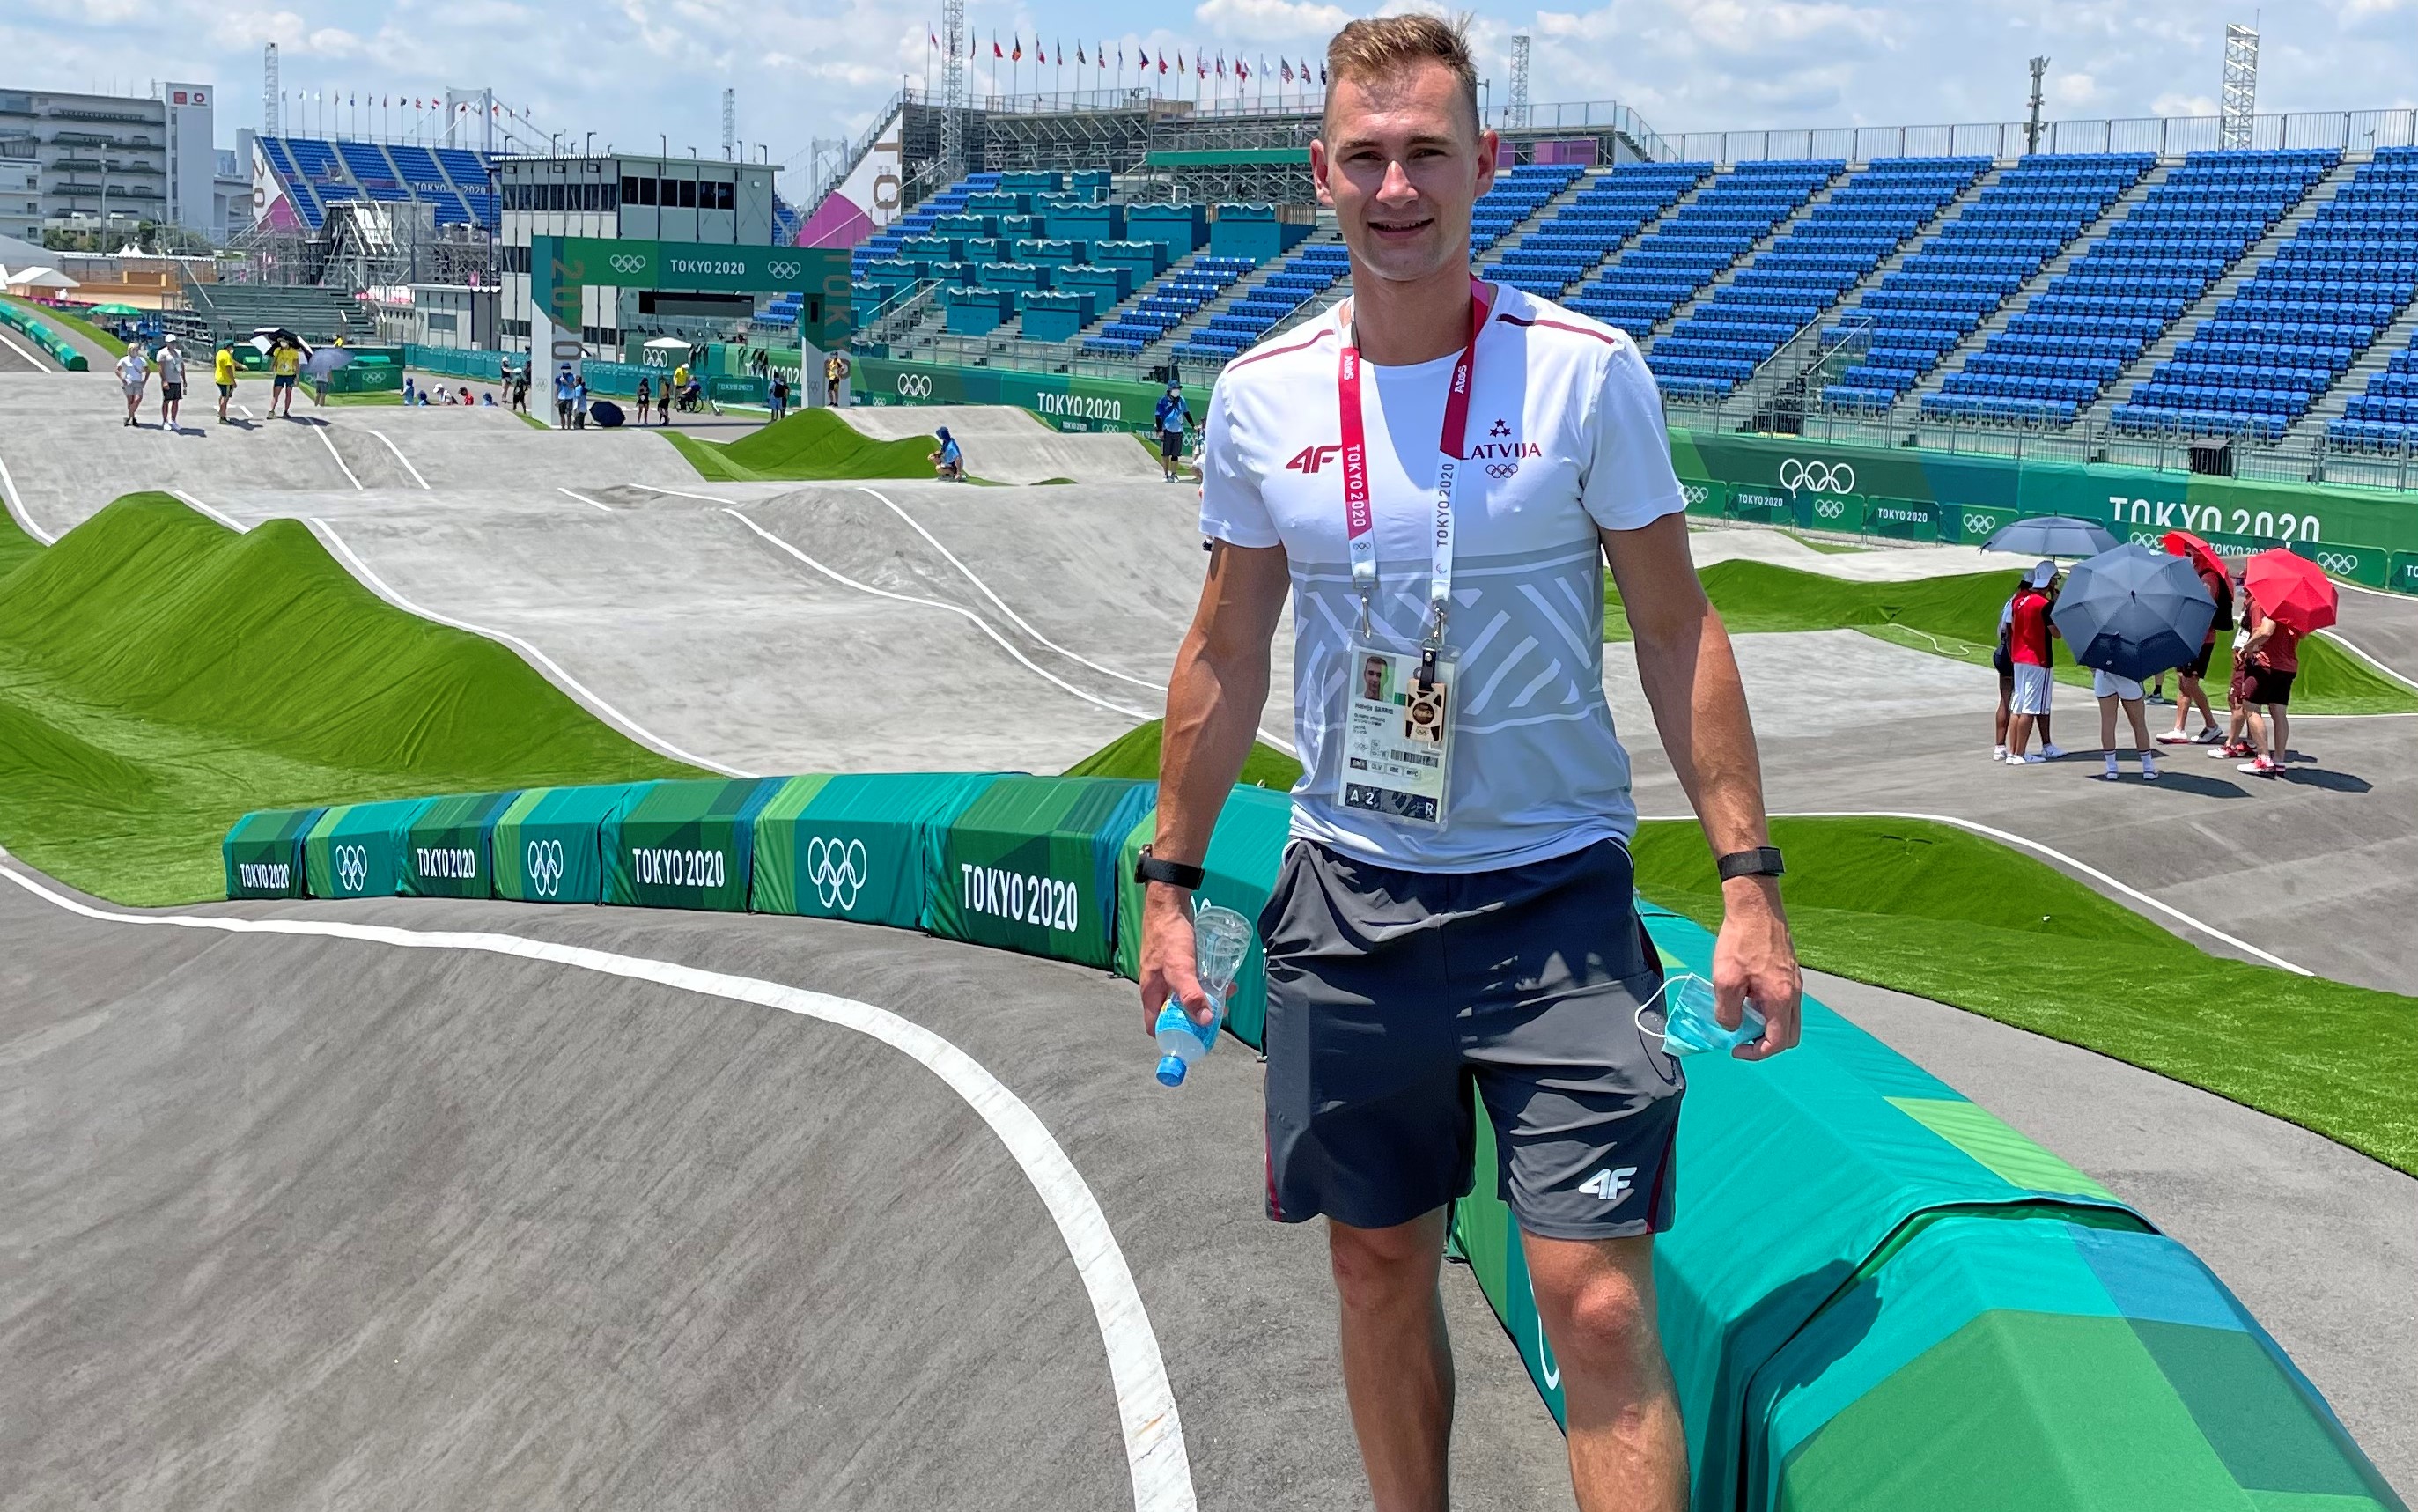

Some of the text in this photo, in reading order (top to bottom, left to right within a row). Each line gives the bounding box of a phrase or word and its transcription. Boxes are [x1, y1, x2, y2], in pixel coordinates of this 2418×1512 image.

[415, 182, 486, 195] TOKYO 2020
[670, 259, 746, 275] TOKYO 2020
[1344, 355, 1354, 380] Atos
[1455, 365, 1467, 394] Atos
[1037, 392, 1121, 421] TOKYO 2020
[1286, 445, 1343, 473] 4F
[1461, 442, 1542, 461] LATVIJA
[1347, 444, 1366, 527] TOKYO 2020
[1437, 463, 1455, 548] TOKYO 2020
[1738, 493, 1783, 507] TOKYO 2020
[1877, 508, 1928, 523] TOKYO 2020
[2109, 497, 2223, 532] TOKYO
[1350, 789, 1434, 816] A 2 R
[240, 862, 290, 889] TOKYO 2020
[417, 847, 475, 878] TOKYO 2020
[632, 847, 726, 888] TOKYO 2020
[961, 863, 1079, 933] TOKYO 2020
[1579, 1166, 1638, 1199] 4F
